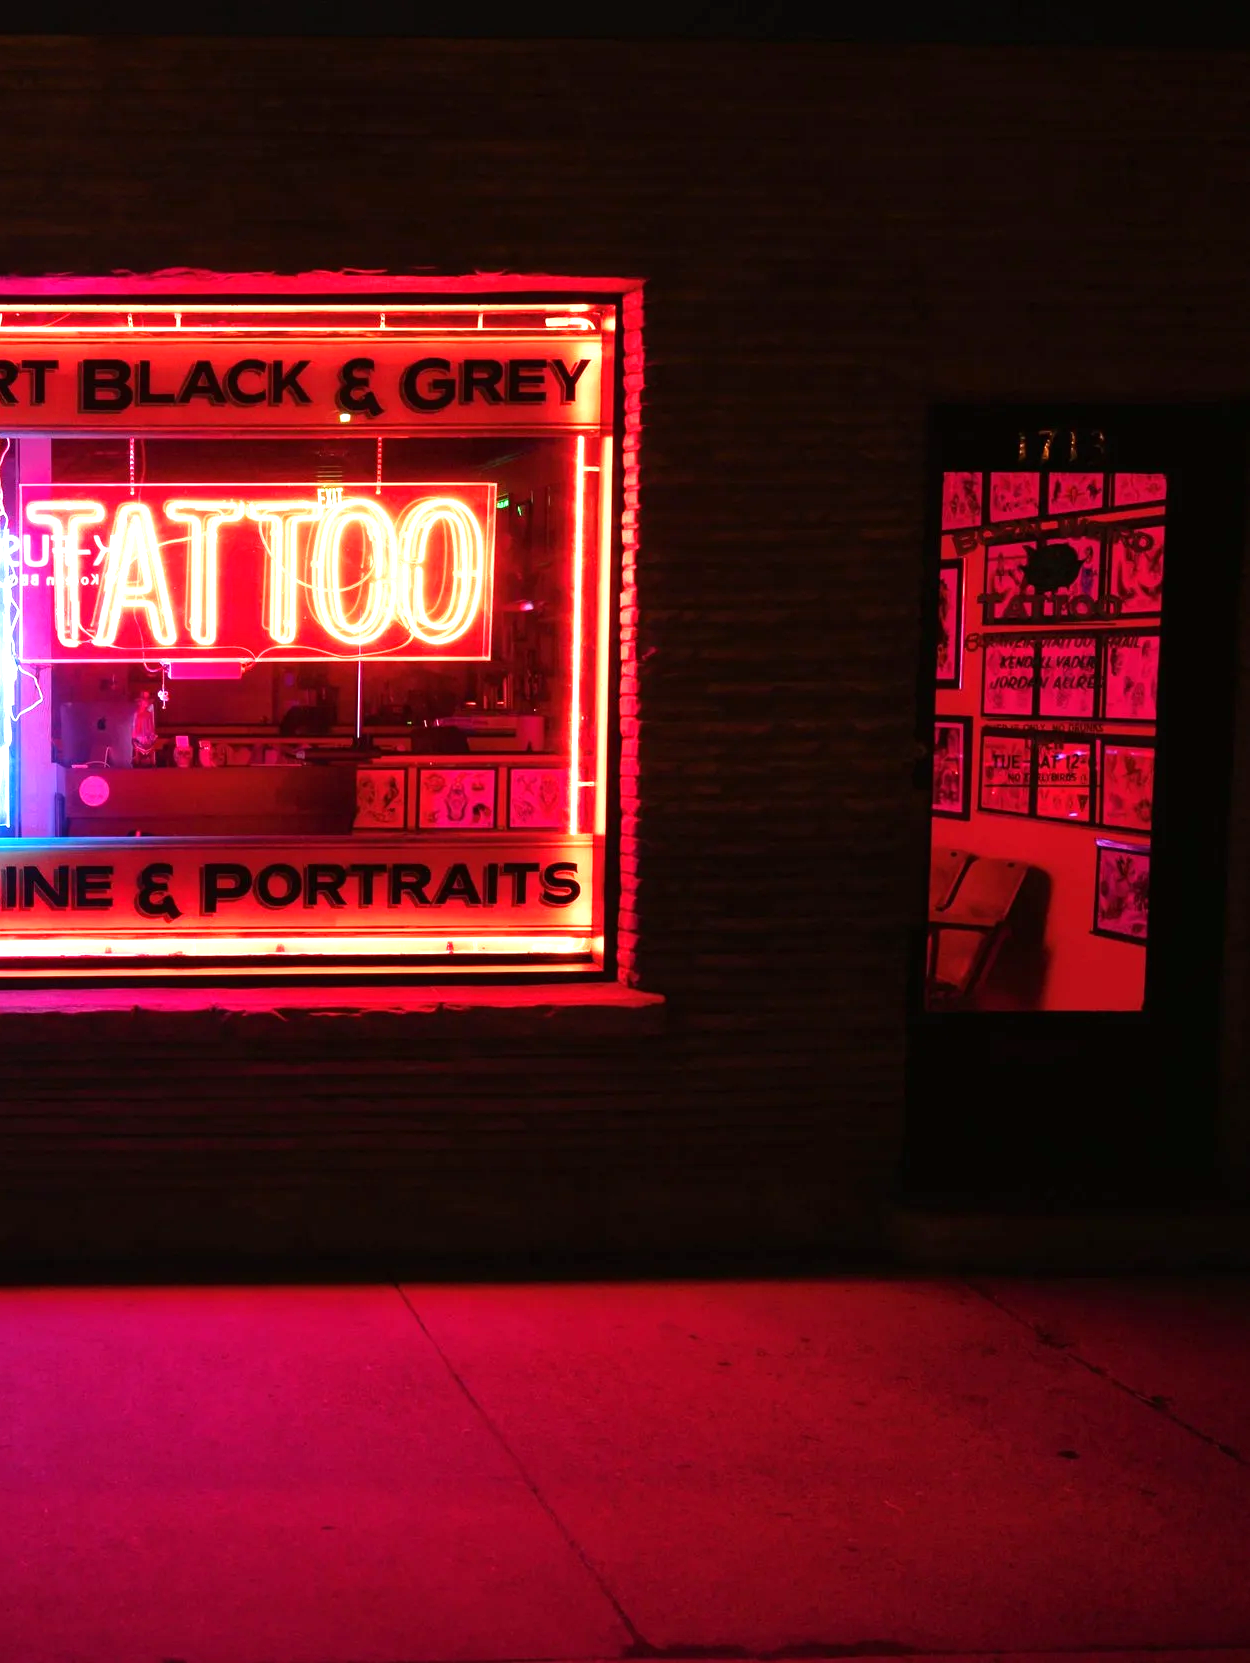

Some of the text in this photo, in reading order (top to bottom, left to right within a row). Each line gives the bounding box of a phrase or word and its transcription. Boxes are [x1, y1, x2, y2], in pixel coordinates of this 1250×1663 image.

[78, 358, 311, 414] BLACK
[335, 357, 384, 418] &
[400, 357, 591, 413] GREY
[317, 487, 343, 507] EXIT
[25, 498, 484, 647] TATTOO
[978, 592, 1122, 623] TATTOO
[1000, 656, 1052, 669] KENDLL
[992, 754, 1062, 770] TUE-AT
[1008, 773, 1020, 782] NO
[134, 863, 183, 923] &
[200, 862, 581, 916] PORTRAITS
